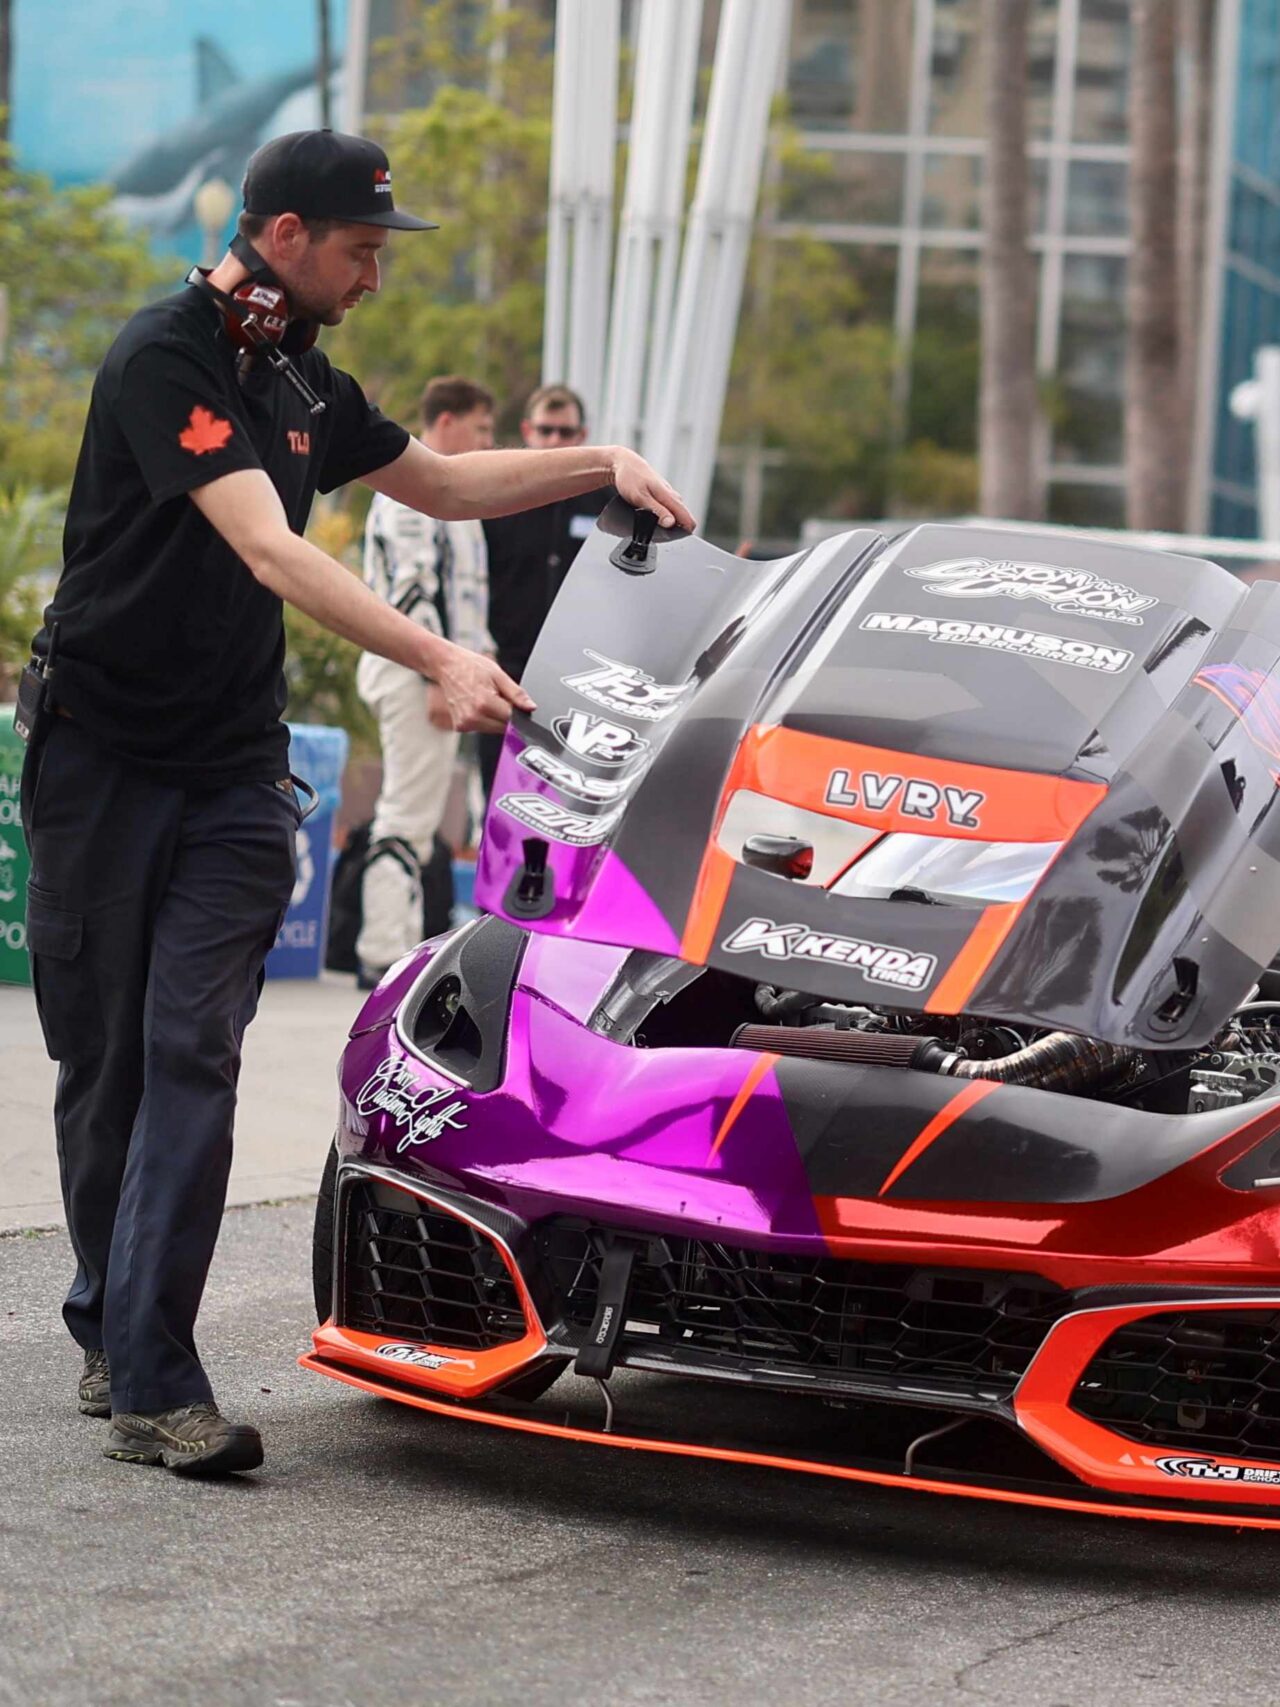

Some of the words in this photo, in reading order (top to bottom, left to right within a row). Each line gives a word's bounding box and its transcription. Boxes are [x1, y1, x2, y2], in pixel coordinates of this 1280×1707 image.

[864, 614, 1130, 666] MAGNUSON
[937, 633, 1121, 672] SUPERCHARGERS
[566, 711, 632, 754] VP
[793, 933, 932, 977] KENDA
[869, 968, 923, 987] TIRES
[596, 1305, 613, 1344] sparco
